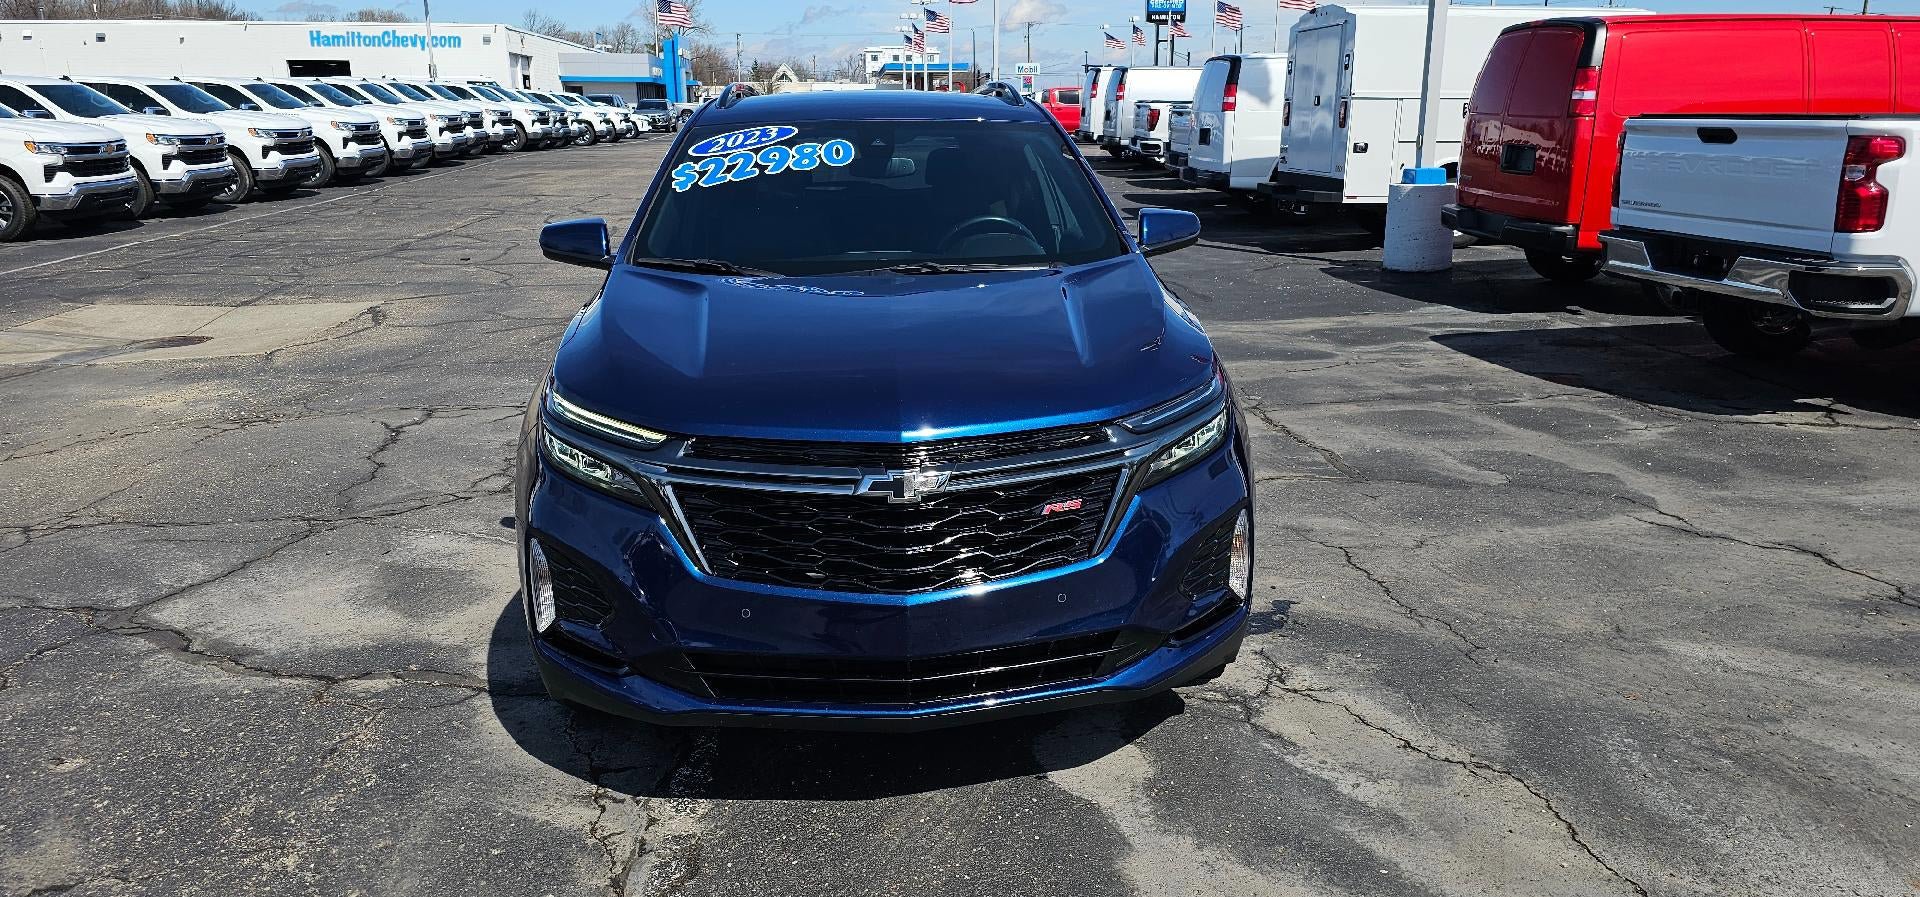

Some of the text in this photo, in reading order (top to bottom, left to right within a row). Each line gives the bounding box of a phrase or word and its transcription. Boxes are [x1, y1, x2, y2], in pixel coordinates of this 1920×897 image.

[1017, 65, 1038, 74] Mobil
[707, 127, 779, 153] 2023
[672, 139, 855, 192] $22980
[1041, 499, 1082, 515] RS
